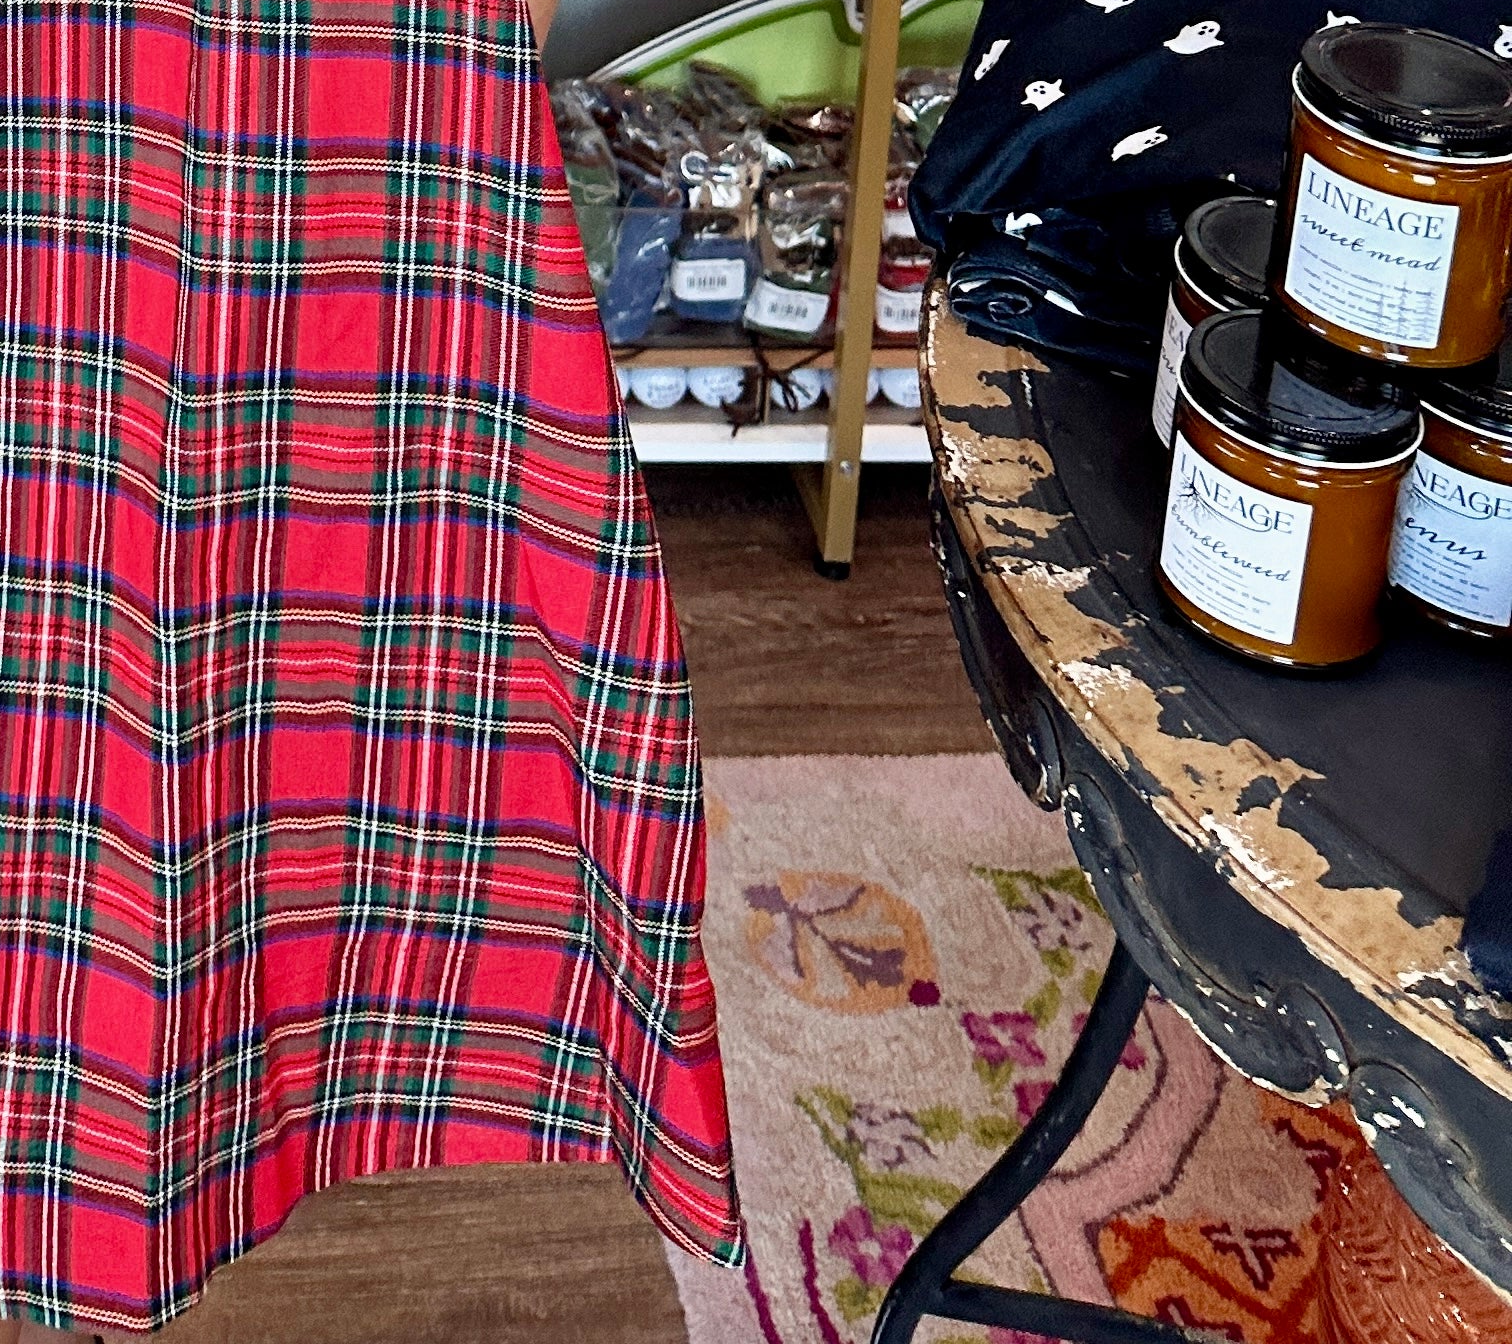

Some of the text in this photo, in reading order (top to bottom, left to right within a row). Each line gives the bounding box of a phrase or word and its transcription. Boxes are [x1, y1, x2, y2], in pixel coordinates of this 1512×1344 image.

[1307, 169, 1445, 241] LINEAGE
[1300, 214, 1441, 272] sweet mead
[1180, 452, 1295, 535] LINEAGE
